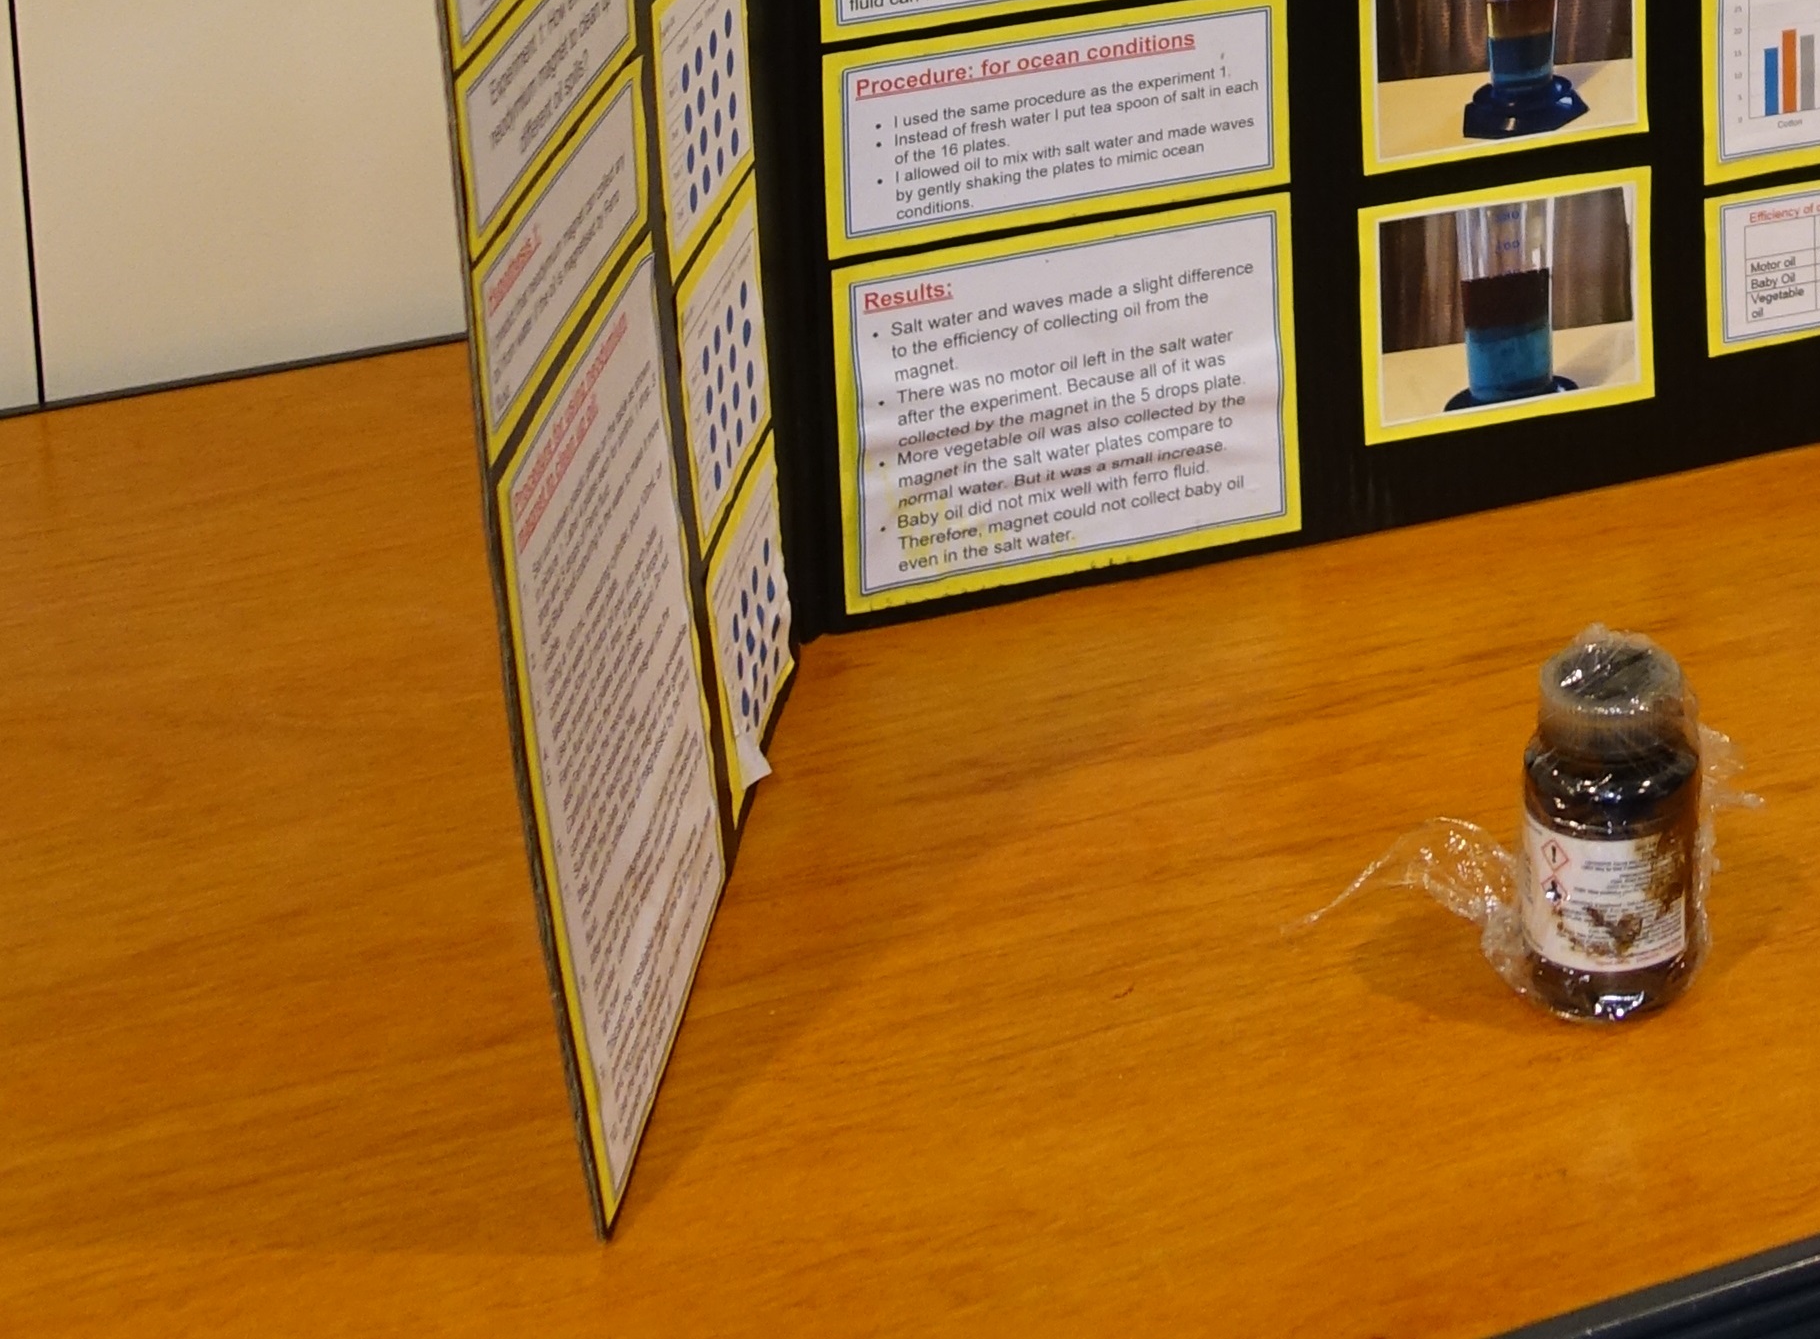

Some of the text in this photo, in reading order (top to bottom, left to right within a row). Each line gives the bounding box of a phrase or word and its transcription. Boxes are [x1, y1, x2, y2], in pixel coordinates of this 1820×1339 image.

[856, 33, 1195, 97] Procedure: for ocean conditions
[864, 283, 953, 311] Results:
[891, 263, 1253, 336] Salt water and waves made a slight difference
